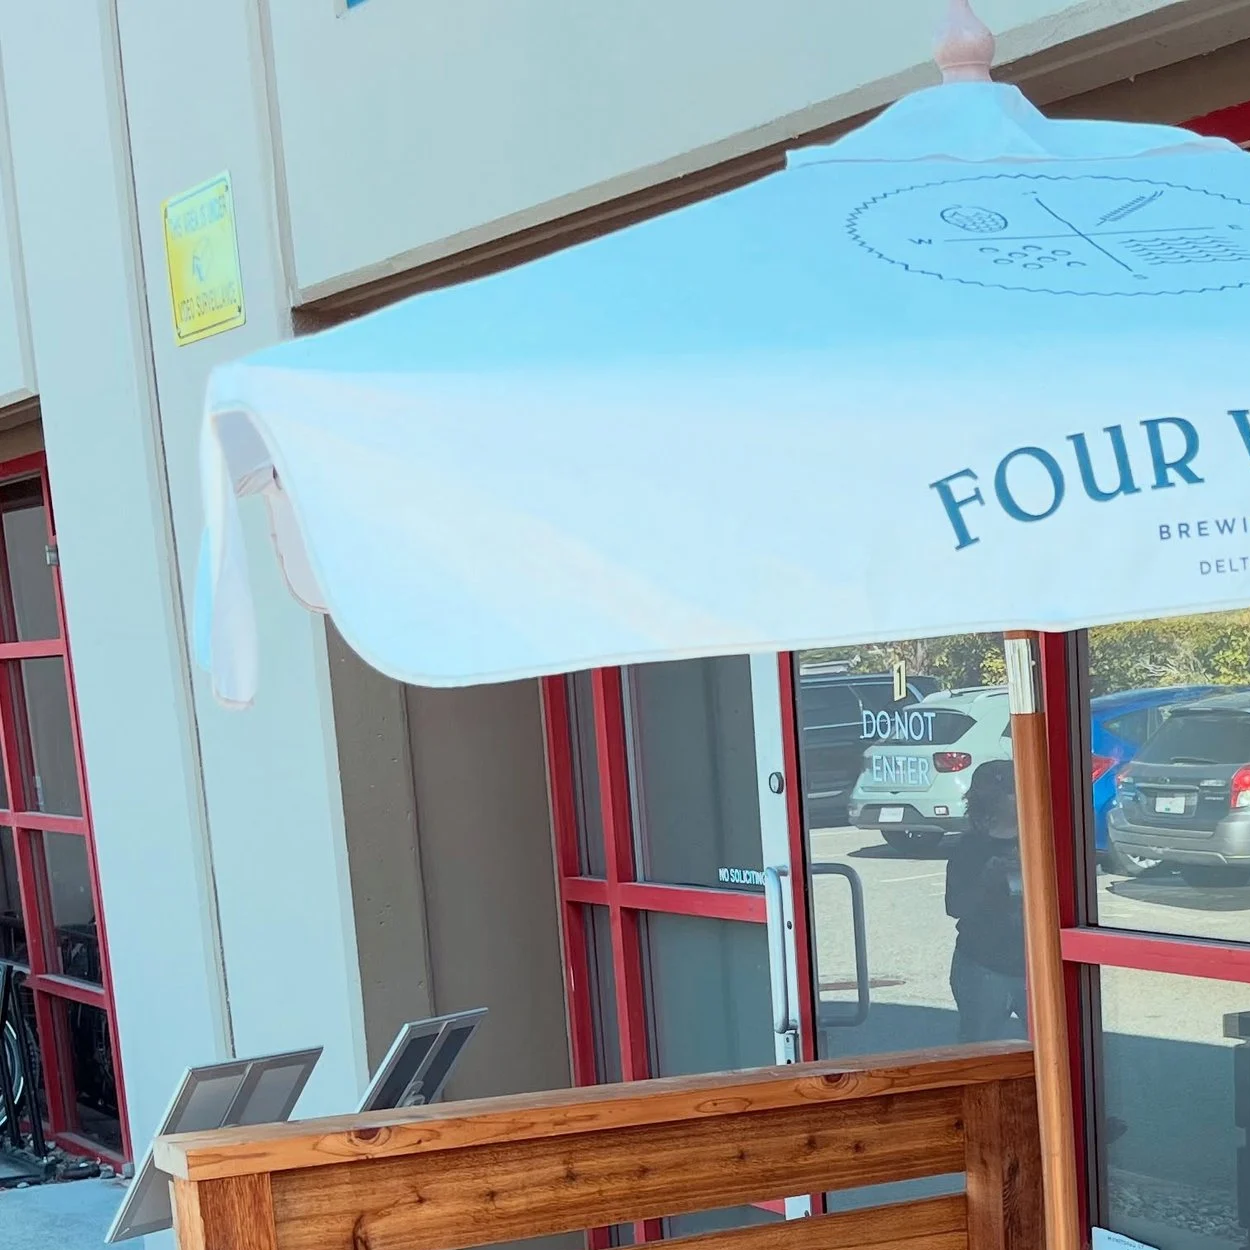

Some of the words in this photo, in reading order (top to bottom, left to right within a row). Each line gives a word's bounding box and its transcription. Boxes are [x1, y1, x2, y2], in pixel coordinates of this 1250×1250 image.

[929, 416, 1205, 551] FOUR
[863, 710, 891, 740] DO
[895, 711, 936, 741] NOT
[872, 755, 931, 785] ENTER
[719, 867, 729, 881] NO
